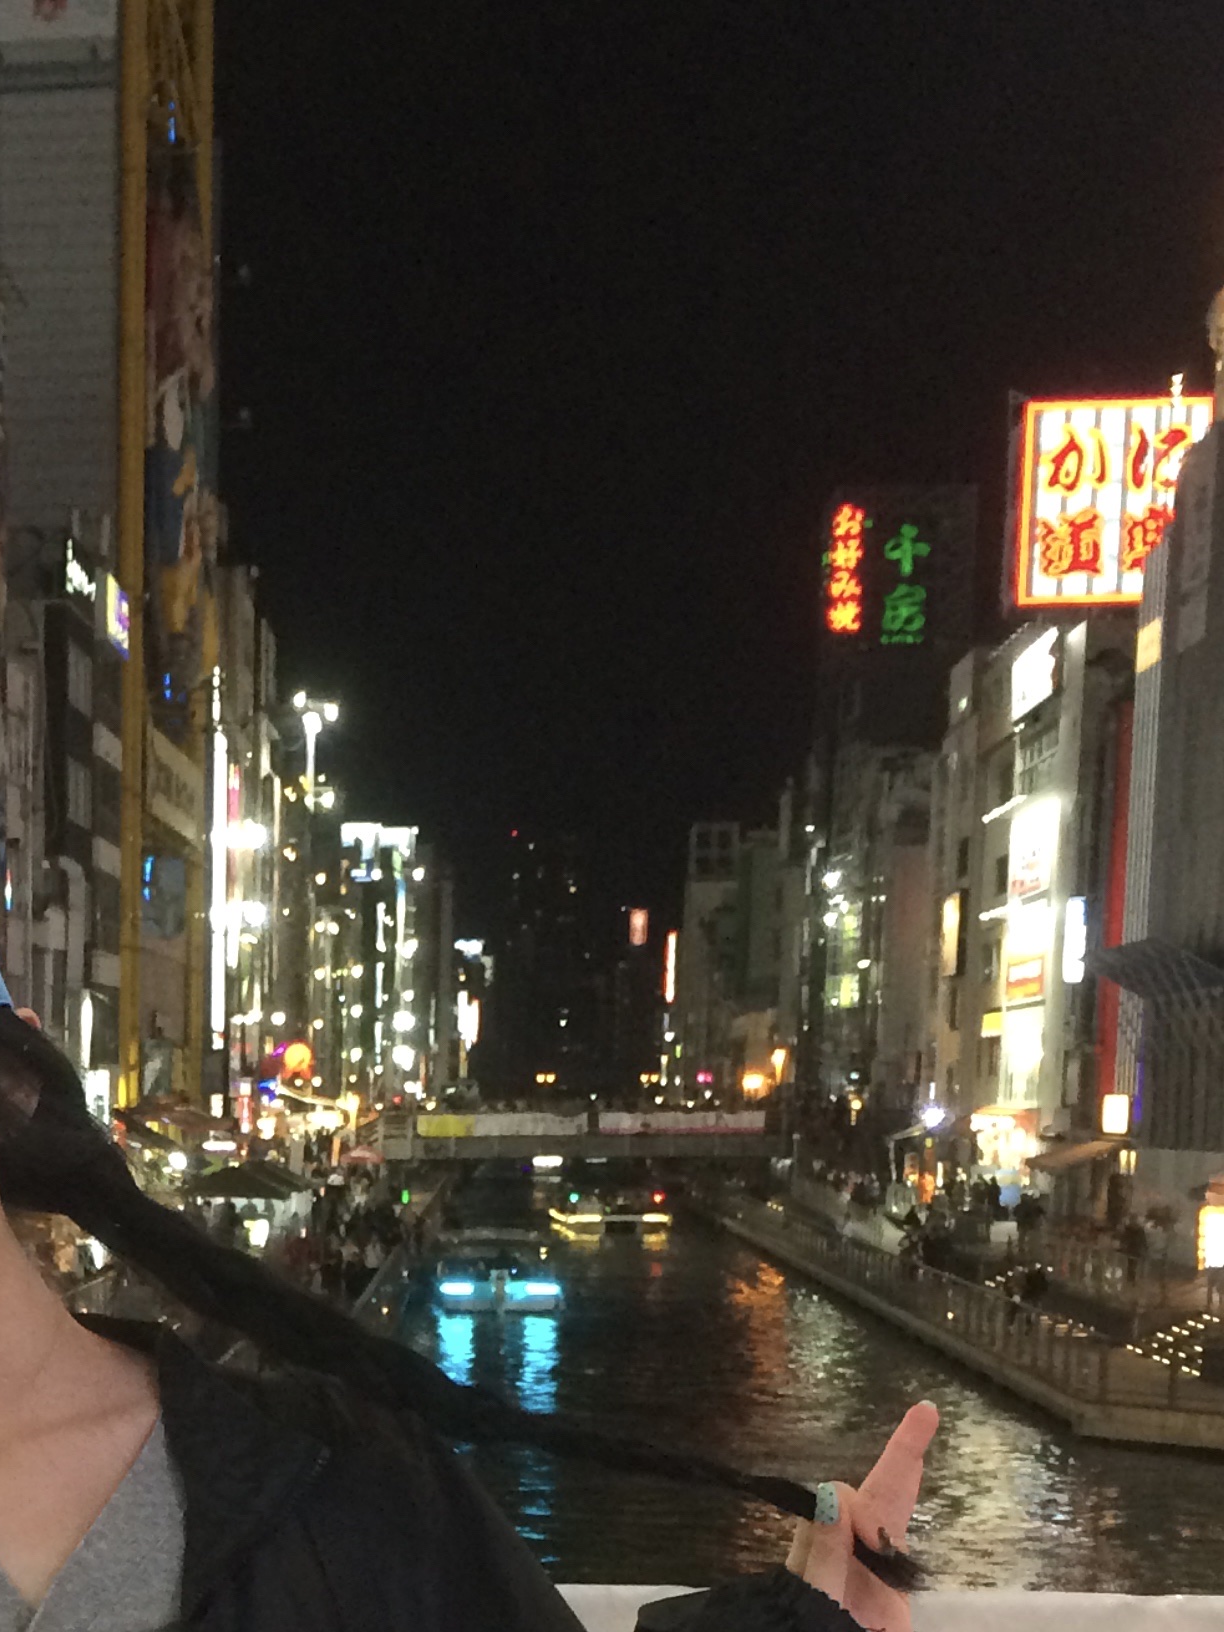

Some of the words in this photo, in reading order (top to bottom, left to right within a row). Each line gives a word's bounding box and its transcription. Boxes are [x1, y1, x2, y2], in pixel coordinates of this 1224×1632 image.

[1040, 423, 1192, 493] かに
[827, 503, 865, 633] お好み焼
[884, 523, 931, 632] 千房
